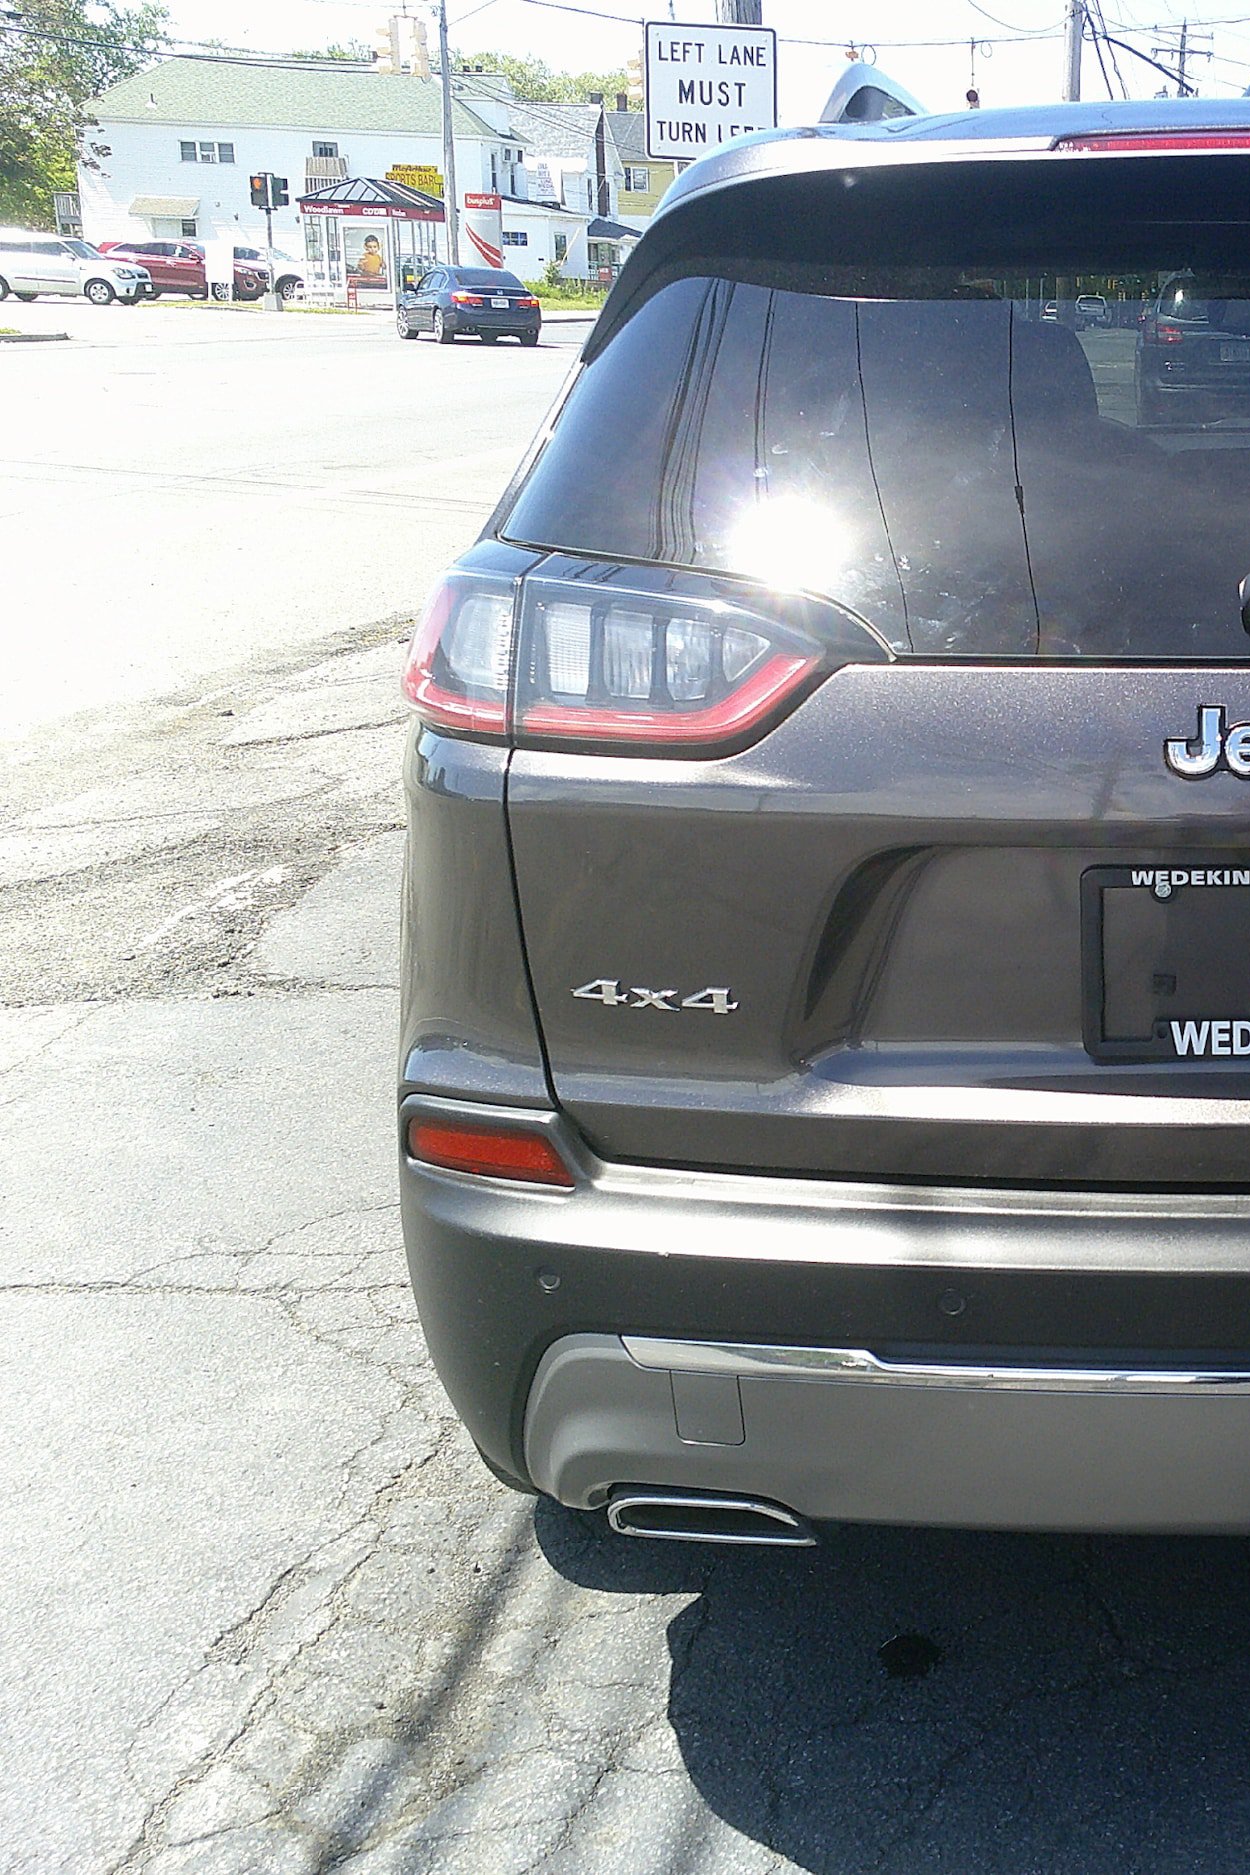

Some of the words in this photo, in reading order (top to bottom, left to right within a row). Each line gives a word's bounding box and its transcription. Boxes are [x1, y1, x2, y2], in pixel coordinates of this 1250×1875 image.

[658, 40, 705, 64] LEFT
[718, 44, 767, 67] LANE
[678, 78, 746, 107] MUST
[656, 120, 706, 144] TURN
[303, 205, 345, 215] Woodlawn
[570, 979, 739, 1014] 4x4
